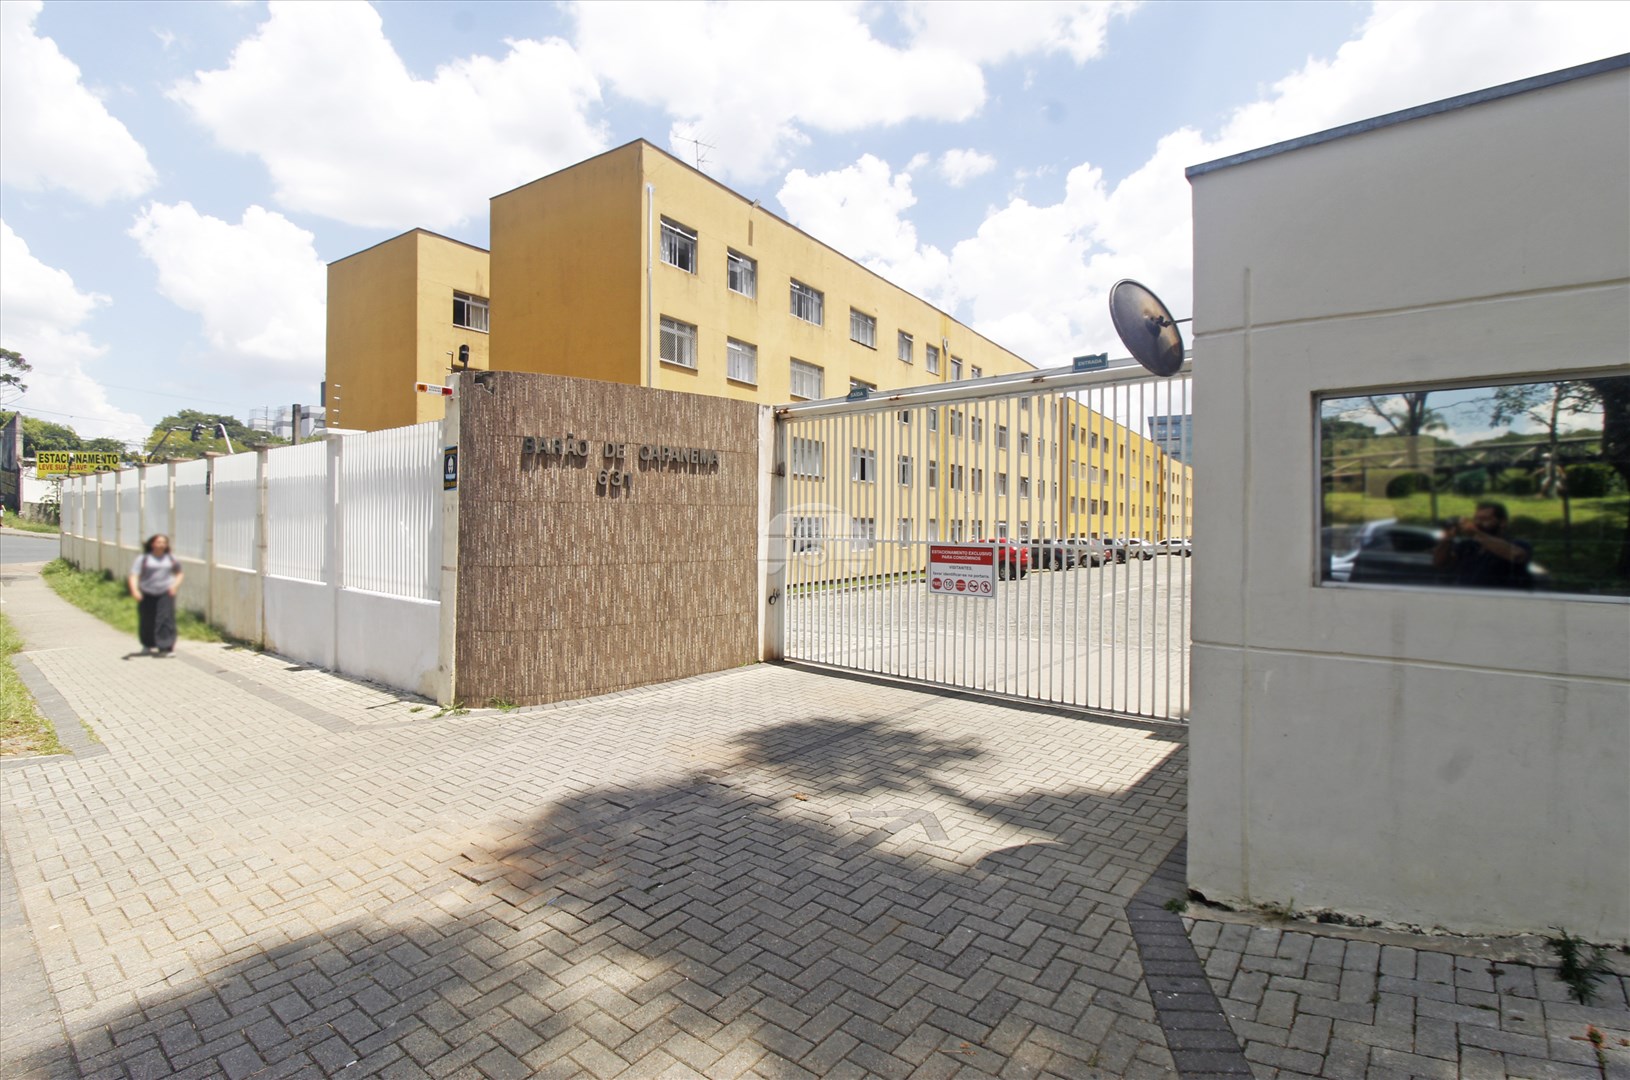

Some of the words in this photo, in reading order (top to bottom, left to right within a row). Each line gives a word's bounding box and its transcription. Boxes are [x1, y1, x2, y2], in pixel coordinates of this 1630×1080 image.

[38, 453, 118, 464] ESTACINAMENTO
[523, 433, 590, 457] BARÃO
[604, 441, 625, 459] DE
[639, 445, 719, 465] CAPANEMA
[597, 469, 633, 488] 631
